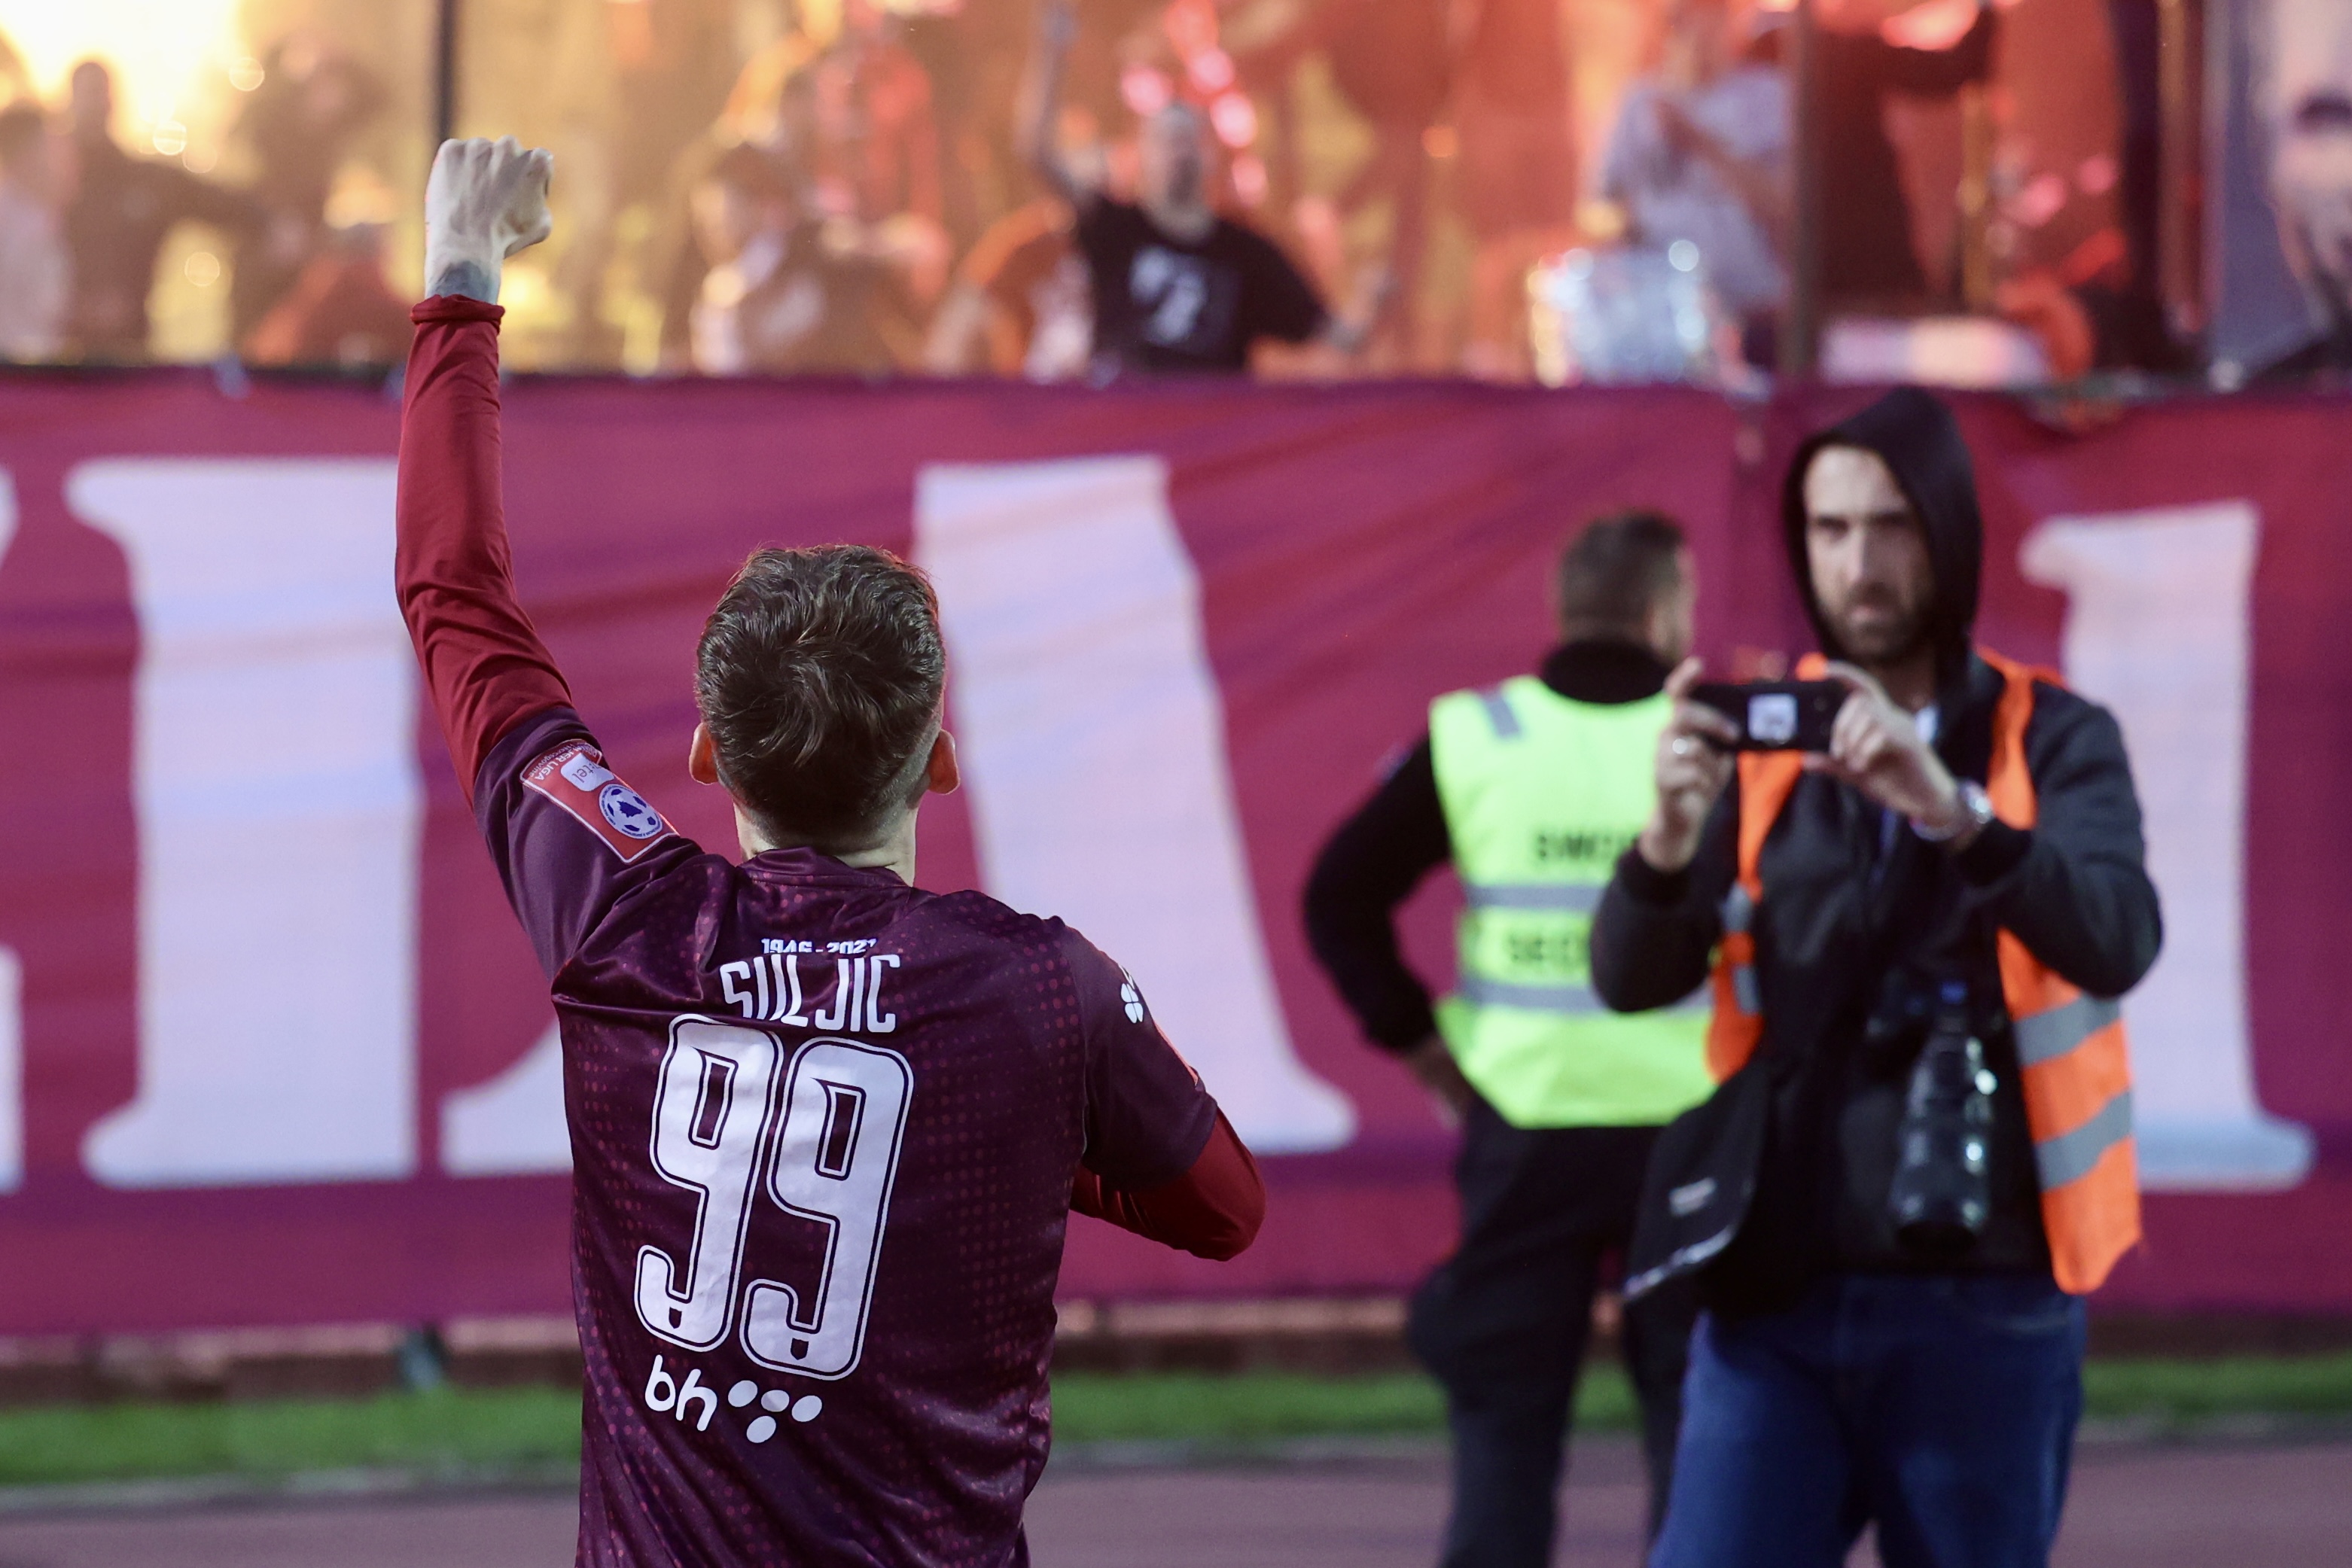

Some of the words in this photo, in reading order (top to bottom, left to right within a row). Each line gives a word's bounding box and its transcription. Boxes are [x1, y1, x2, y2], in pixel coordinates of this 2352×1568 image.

[535, 761, 559, 780] LIGA
[634, 1013, 914, 1381] 99
[644, 1355, 717, 1431] bh
